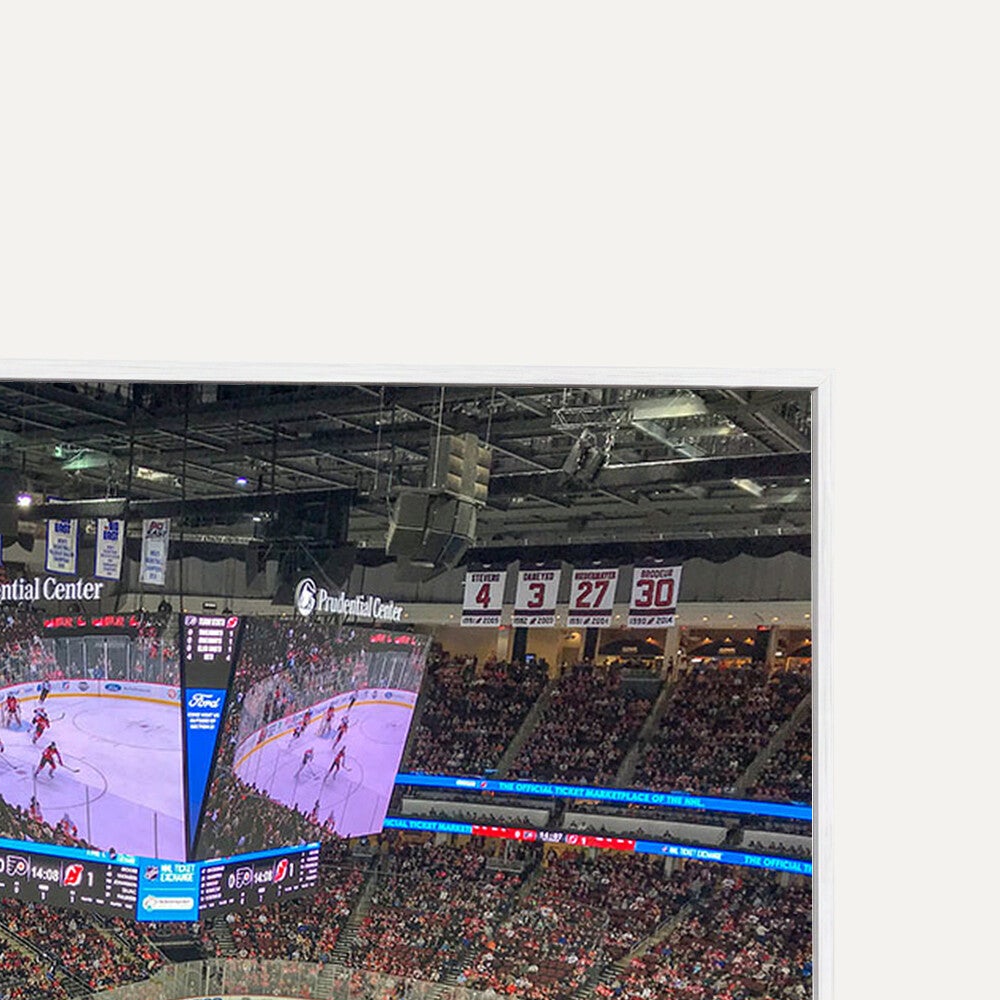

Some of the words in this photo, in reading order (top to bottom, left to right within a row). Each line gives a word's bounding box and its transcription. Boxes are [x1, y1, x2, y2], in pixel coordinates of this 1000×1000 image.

[43, 577, 104, 600] Center
[475, 583, 491, 608] 4
[527, 583, 546, 608] 3
[576, 580, 610, 608] 27
[635, 578, 675, 607] 30
[317, 588, 373, 617] Prudential
[373, 597, 404, 621] Center
[188, 693, 221, 708] Ford
[500, 782, 514, 790] THE
[515, 783, 553, 793] OFFICIAL
[555, 787, 584, 796] TICKET
[585, 789, 650, 801] MARKETPLACE
[651, 793, 665, 802] OF
[667, 795, 683, 804] THE
[409, 820, 437, 829] TICKET
[289, 863, 294, 877] 1
[744, 856, 761, 865] THE
[763, 857, 802, 870] OFFICIAL
[87, 872, 93, 887] 1
[228, 874, 235, 888] 0
